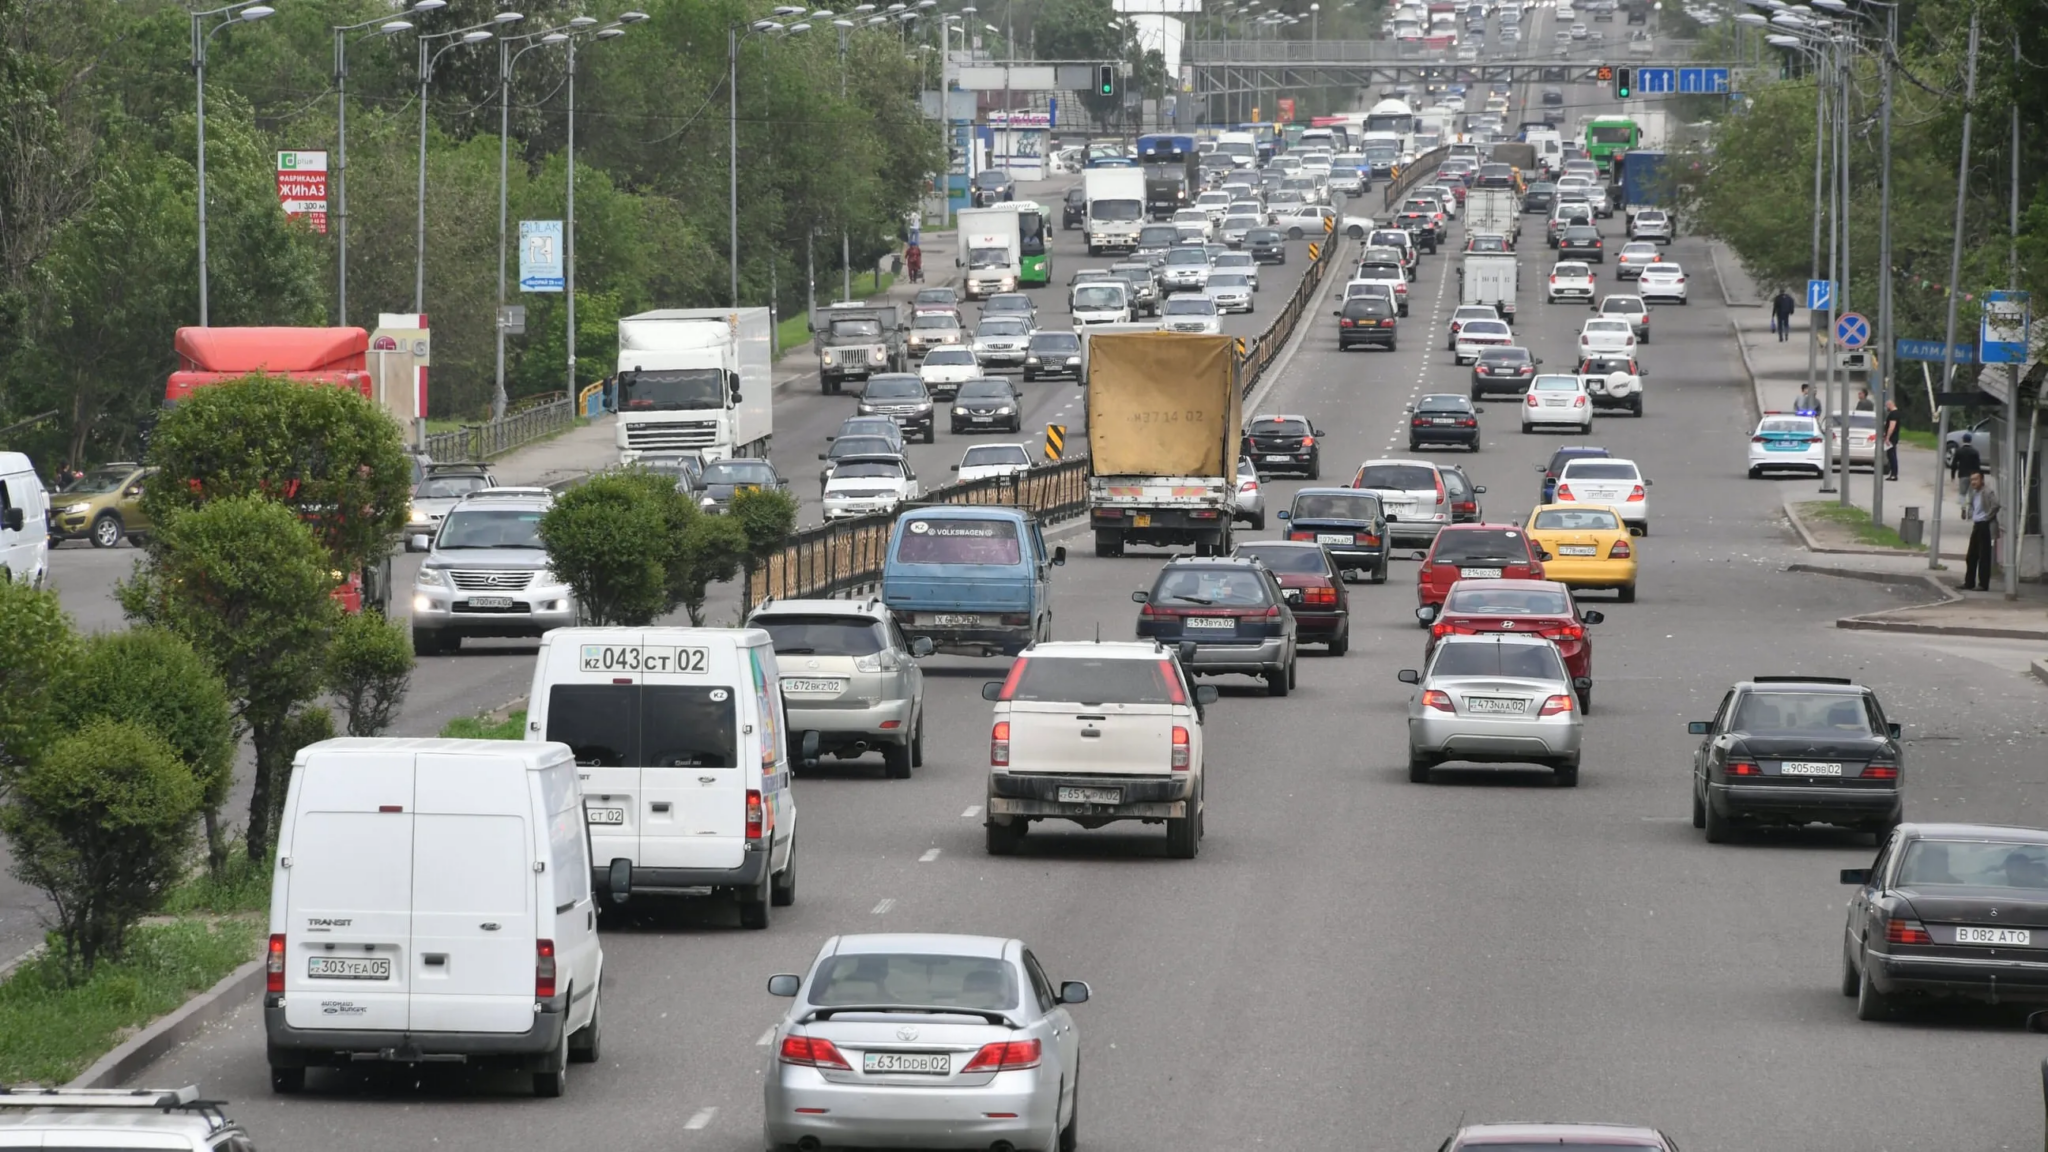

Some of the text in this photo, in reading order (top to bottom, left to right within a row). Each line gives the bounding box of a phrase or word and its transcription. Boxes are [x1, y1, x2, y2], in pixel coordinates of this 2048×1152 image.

[304, 202, 318, 210] 300
[1912, 345, 1965, 358] АЛМАЫ
[936, 528, 984, 536] VOLKSWAGEN
[584, 658, 600, 668] KZ
[308, 918, 352, 926] TRANSIT
[1972, 929, 1994, 942] 082
[1999, 930, 2026, 942] ATO
